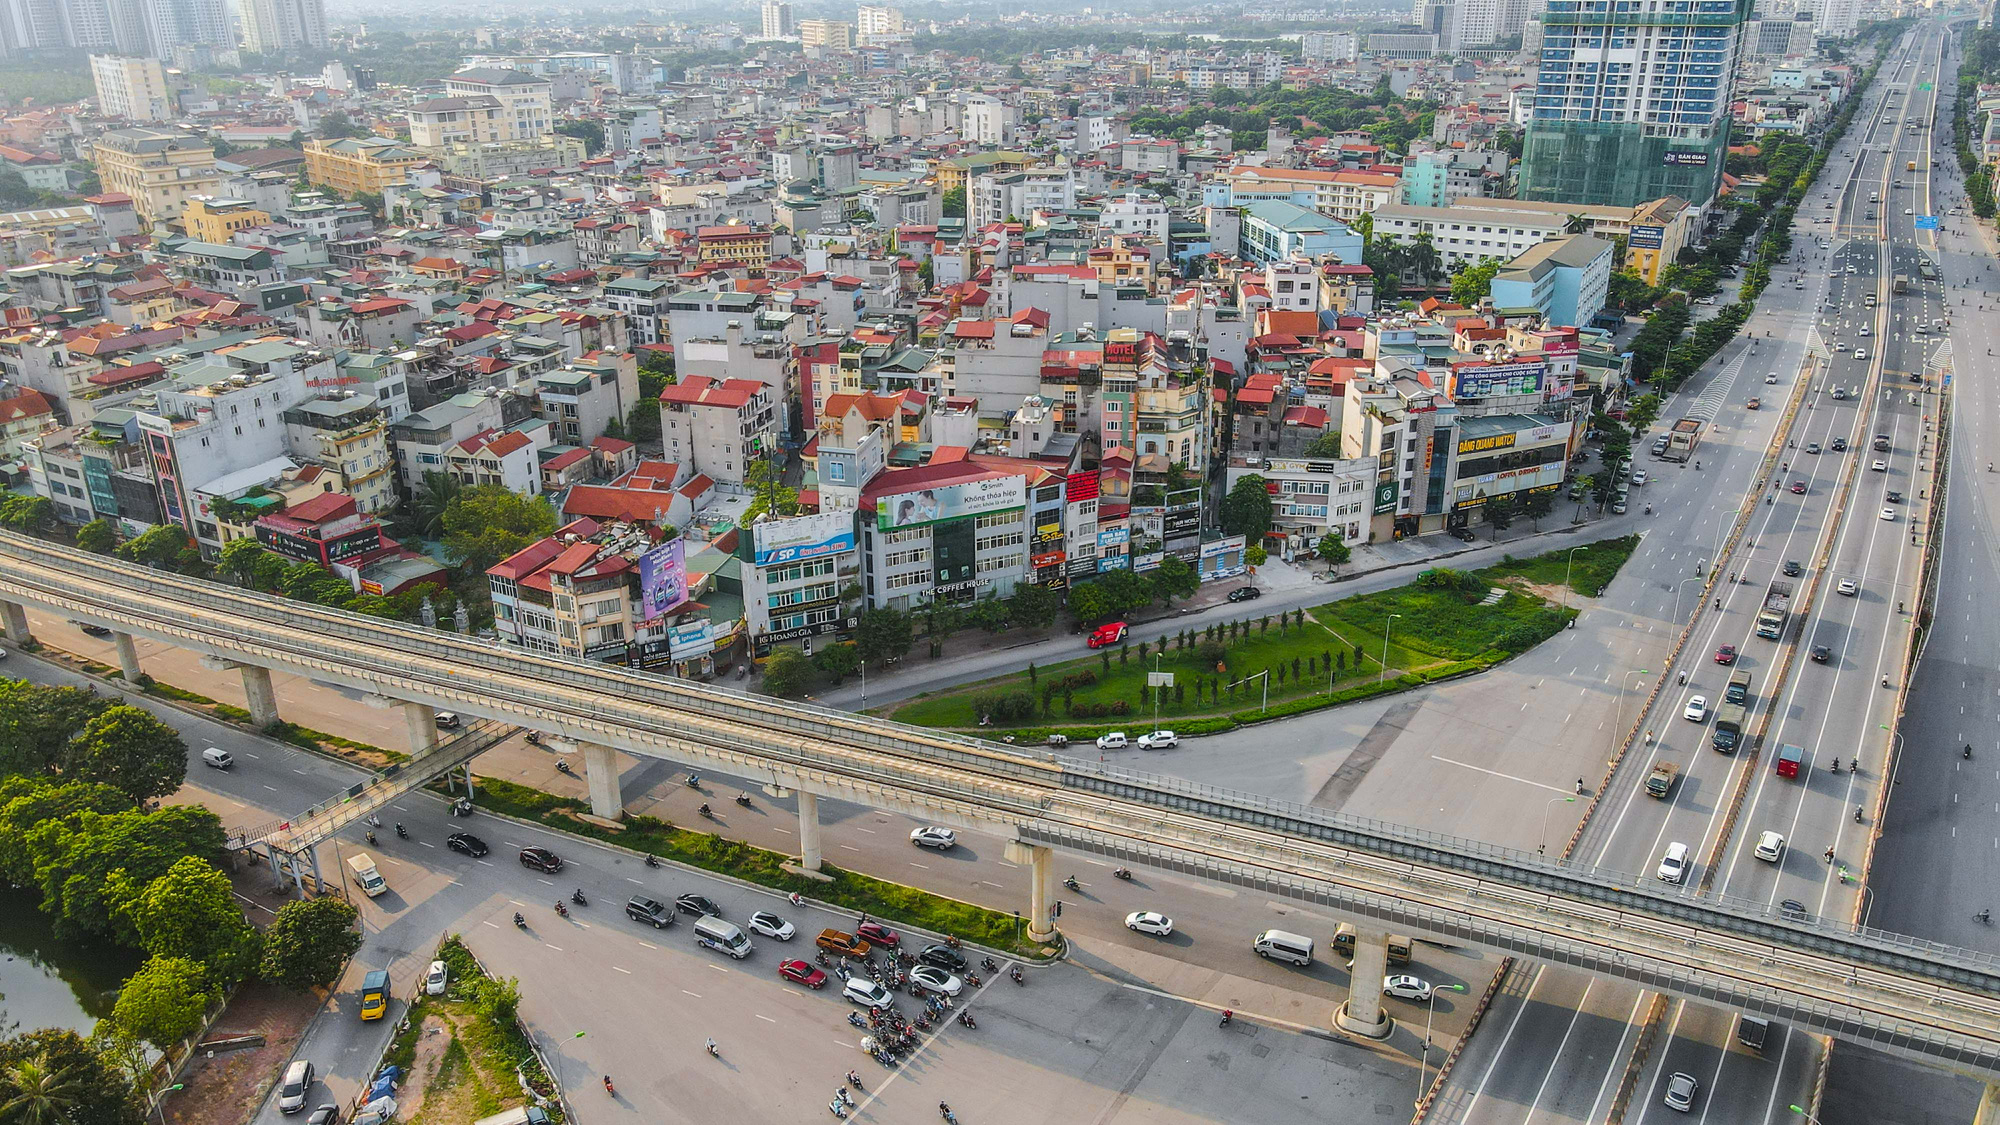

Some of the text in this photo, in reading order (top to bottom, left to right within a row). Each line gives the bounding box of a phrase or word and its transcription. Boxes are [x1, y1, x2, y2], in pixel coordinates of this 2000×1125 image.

[1106, 343, 1136, 355] HOTEL
[1458, 433, 1516, 453] ĐĂNG QUANG WATCH
[1425, 441, 1433, 469] HOTEL
[1518, 466, 1541, 477] DRINKS
[964, 494, 986, 504] Không
[1002, 489, 1017, 498] hiệp
[1184, 516, 1200, 525] WORLD
[1104, 536, 1122, 544] LAPTOP
[778, 548, 796, 561] SP
[921, 578, 990, 597] THE COFFEE HOUSE
[769, 630, 798, 643] HOANG
[798, 627, 813, 637] GIA
